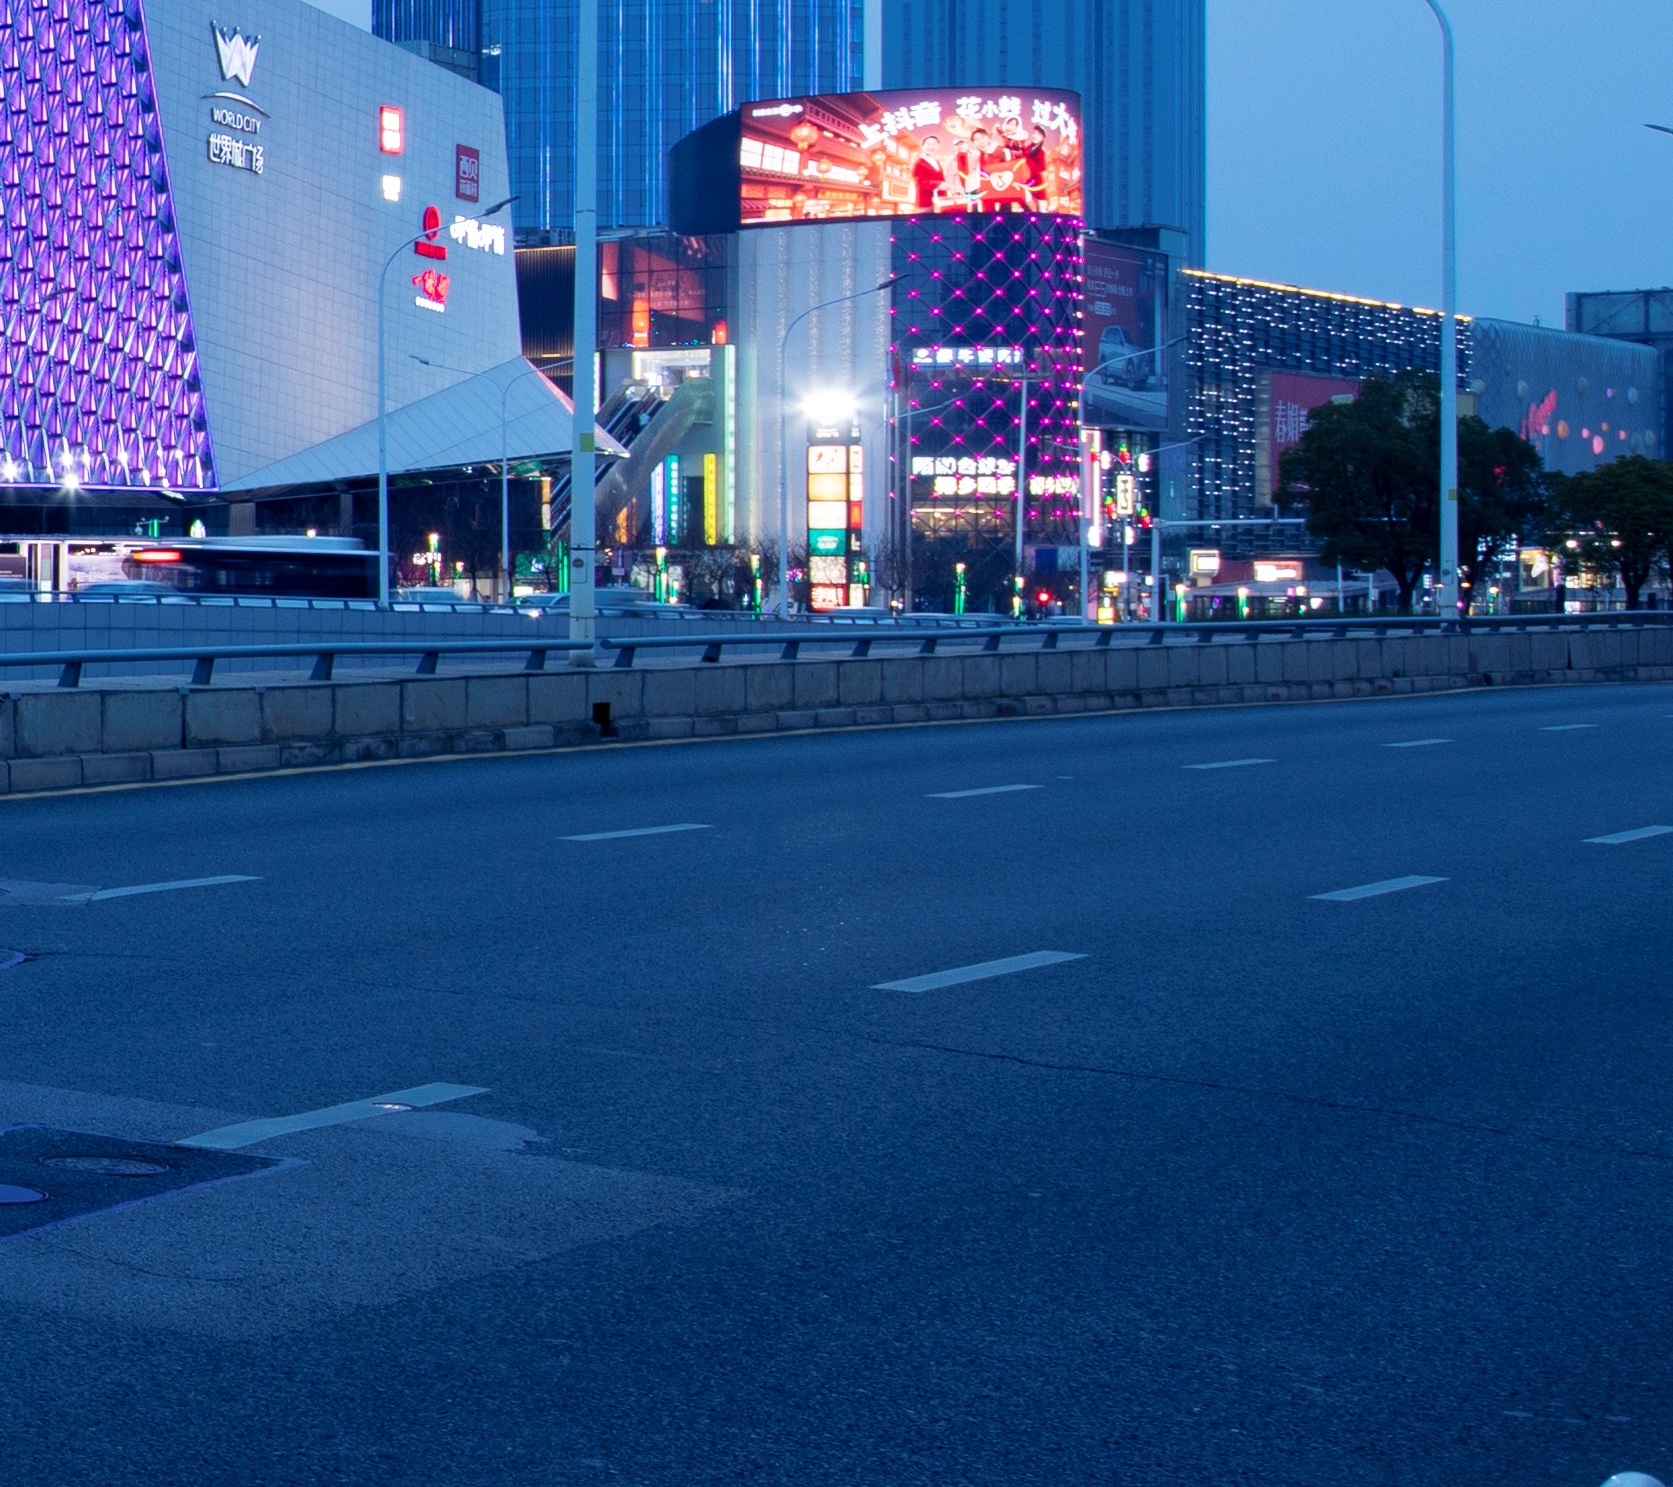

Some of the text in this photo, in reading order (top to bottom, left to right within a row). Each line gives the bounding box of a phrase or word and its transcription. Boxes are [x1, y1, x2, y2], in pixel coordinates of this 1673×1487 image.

[212, 107, 262, 134] WORLD CITY
[209, 133, 265, 174] 世界城广场
